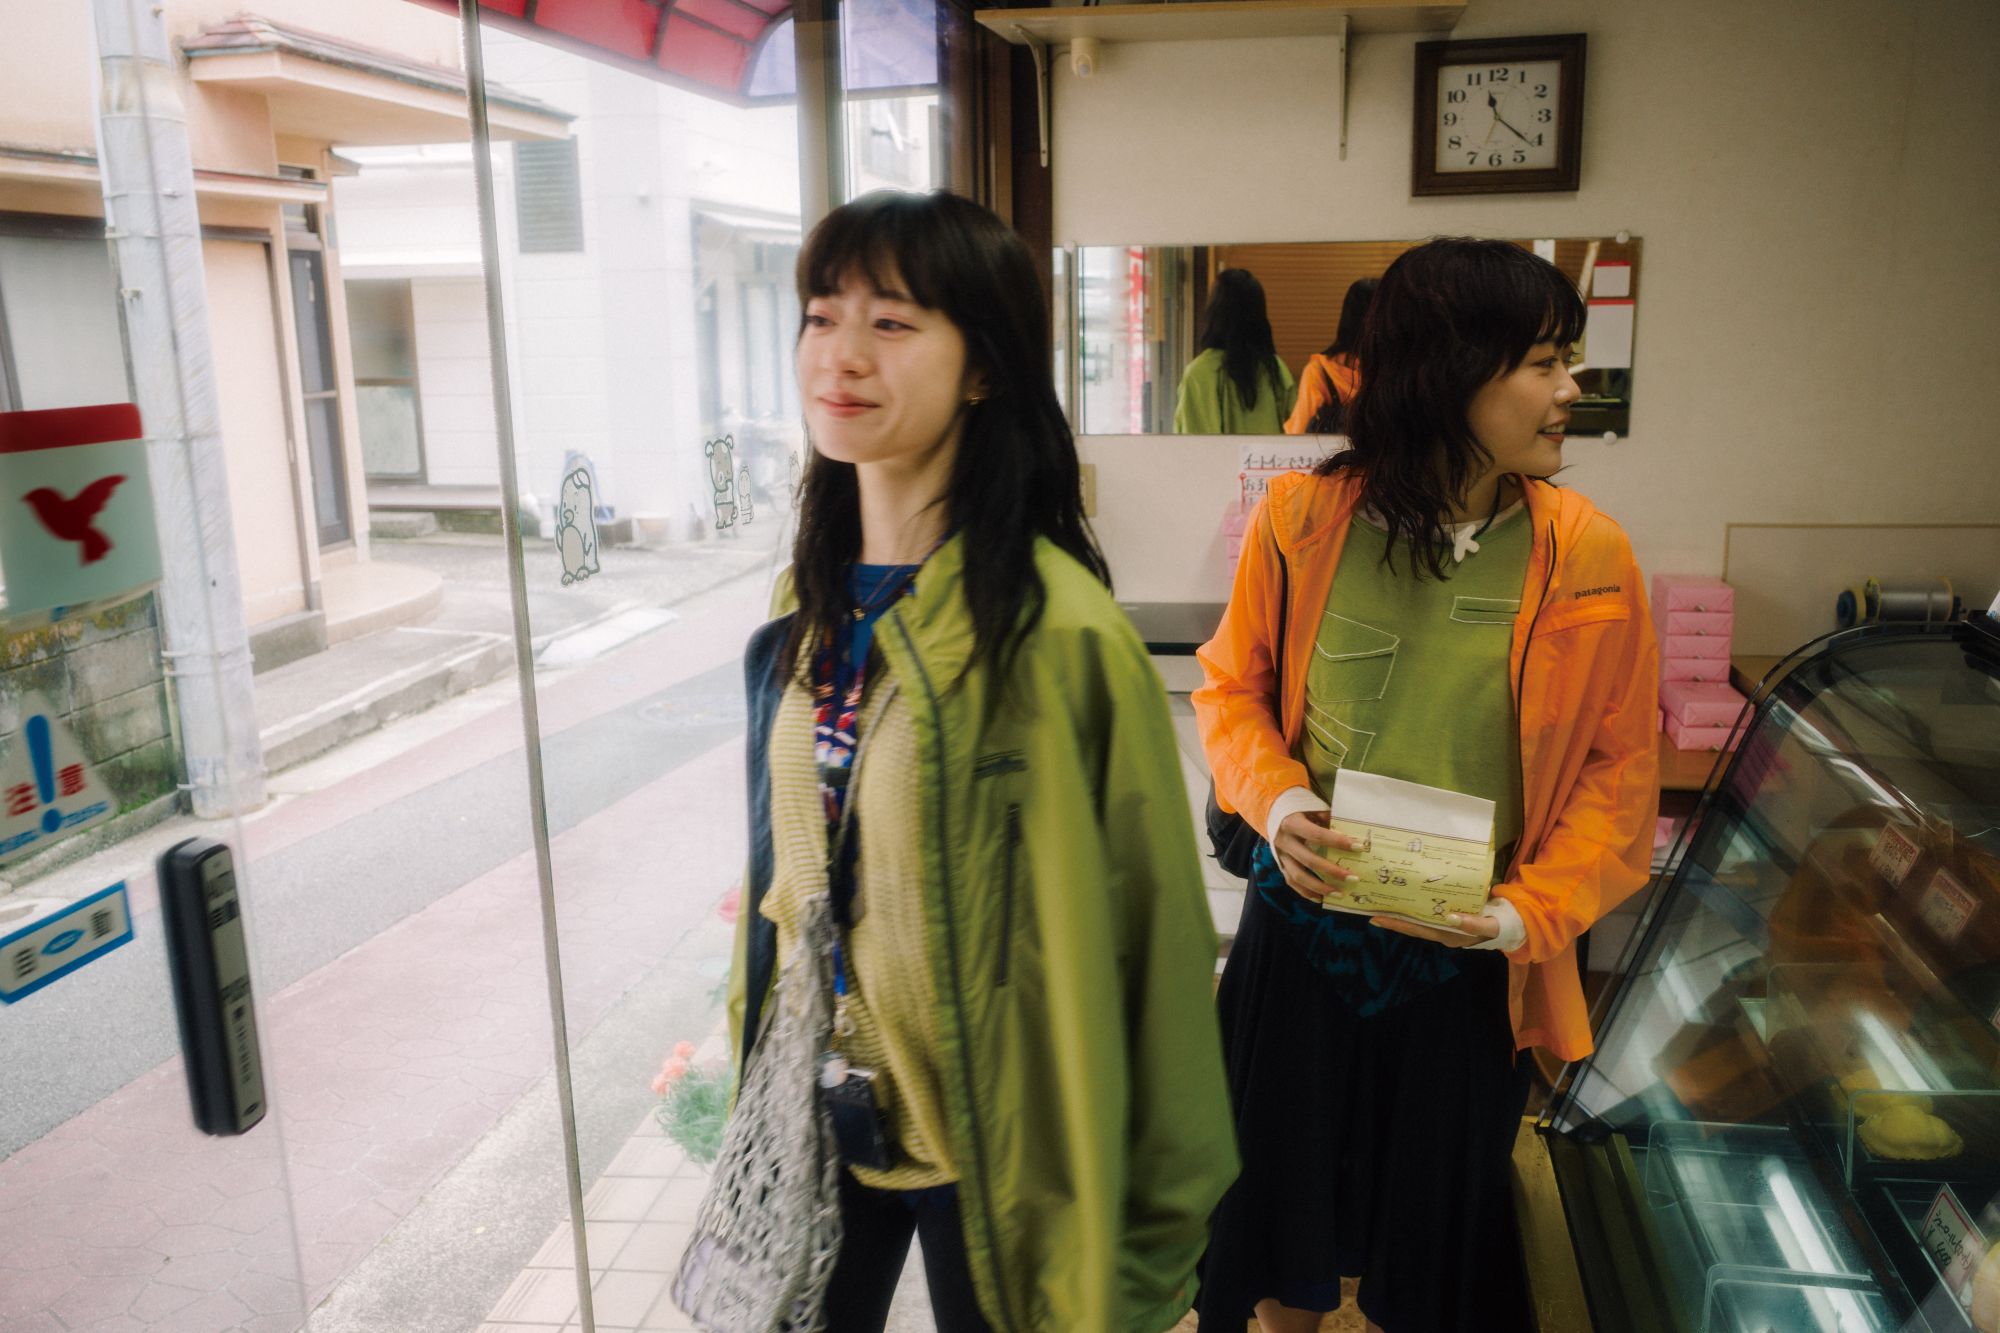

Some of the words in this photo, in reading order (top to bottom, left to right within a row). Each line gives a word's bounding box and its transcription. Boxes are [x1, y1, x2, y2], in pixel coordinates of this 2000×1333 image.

[1466, 73, 1482, 86] 11
[1488, 67, 1509, 82] 12
[1519, 71, 1527, 84] 1
[1447, 89, 1467, 103] 10
[1534, 84, 1548, 98] 2
[1443, 112, 1457, 126] 9
[1537, 108, 1552, 123] 3
[1447, 135, 1462, 150] 8
[1532, 133, 1544, 147] 4
[1466, 151, 1479, 165] 7
[1488, 153, 1502, 167] 6
[1512, 150, 1526, 163] 5
[1575, 584, 1621, 600] patagonia
[1934, 1241, 1952, 1267] 400
